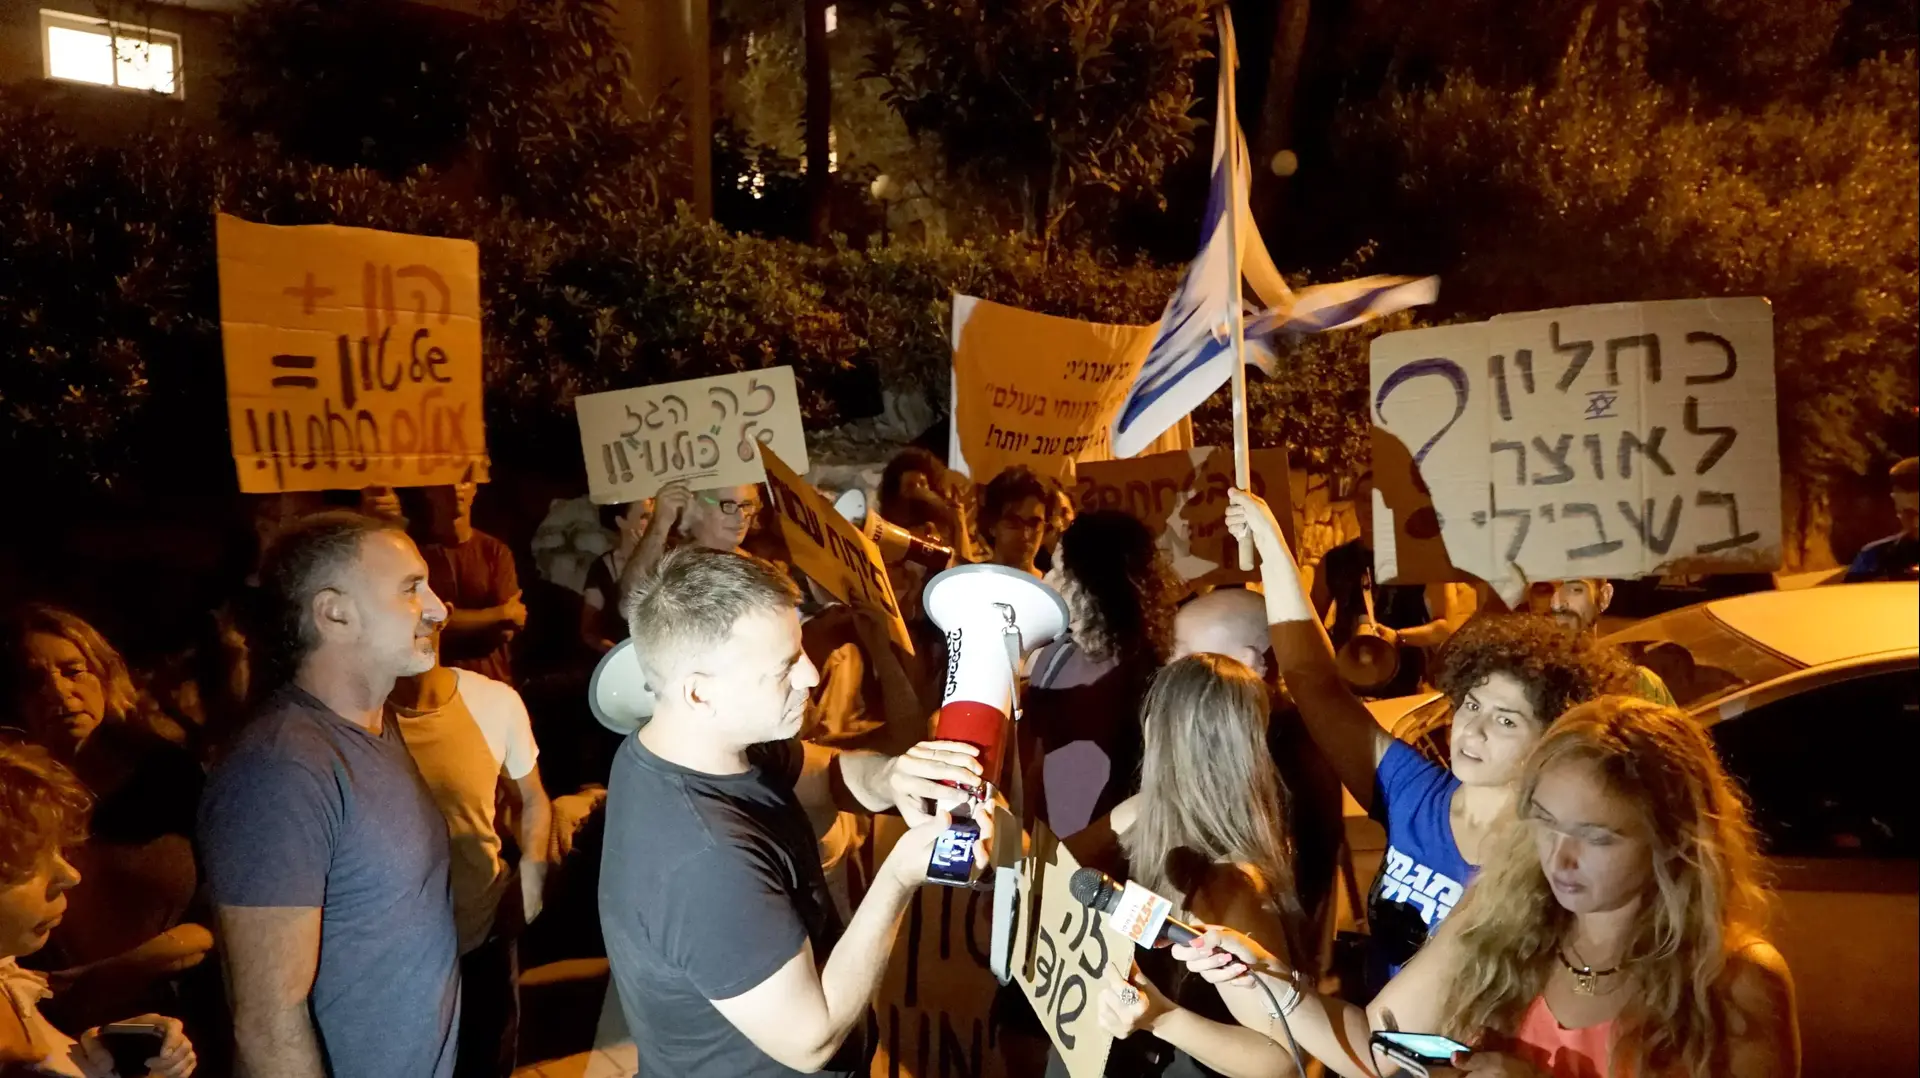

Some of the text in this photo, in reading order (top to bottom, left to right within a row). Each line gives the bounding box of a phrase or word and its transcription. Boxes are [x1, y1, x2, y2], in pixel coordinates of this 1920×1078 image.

[361, 261, 450, 344] הון
[338, 326, 452, 410] שלטון
[620, 378, 776, 438] זה הגז
[1488, 321, 1738, 421] כחלון
[985, 423, 1029, 452] יותר!
[1032, 435, 1061, 456] טוב
[1490, 396, 1738, 485] לאוצר
[1472, 482, 1760, 562] בשבילי
[1059, 903, 1109, 979] זה
